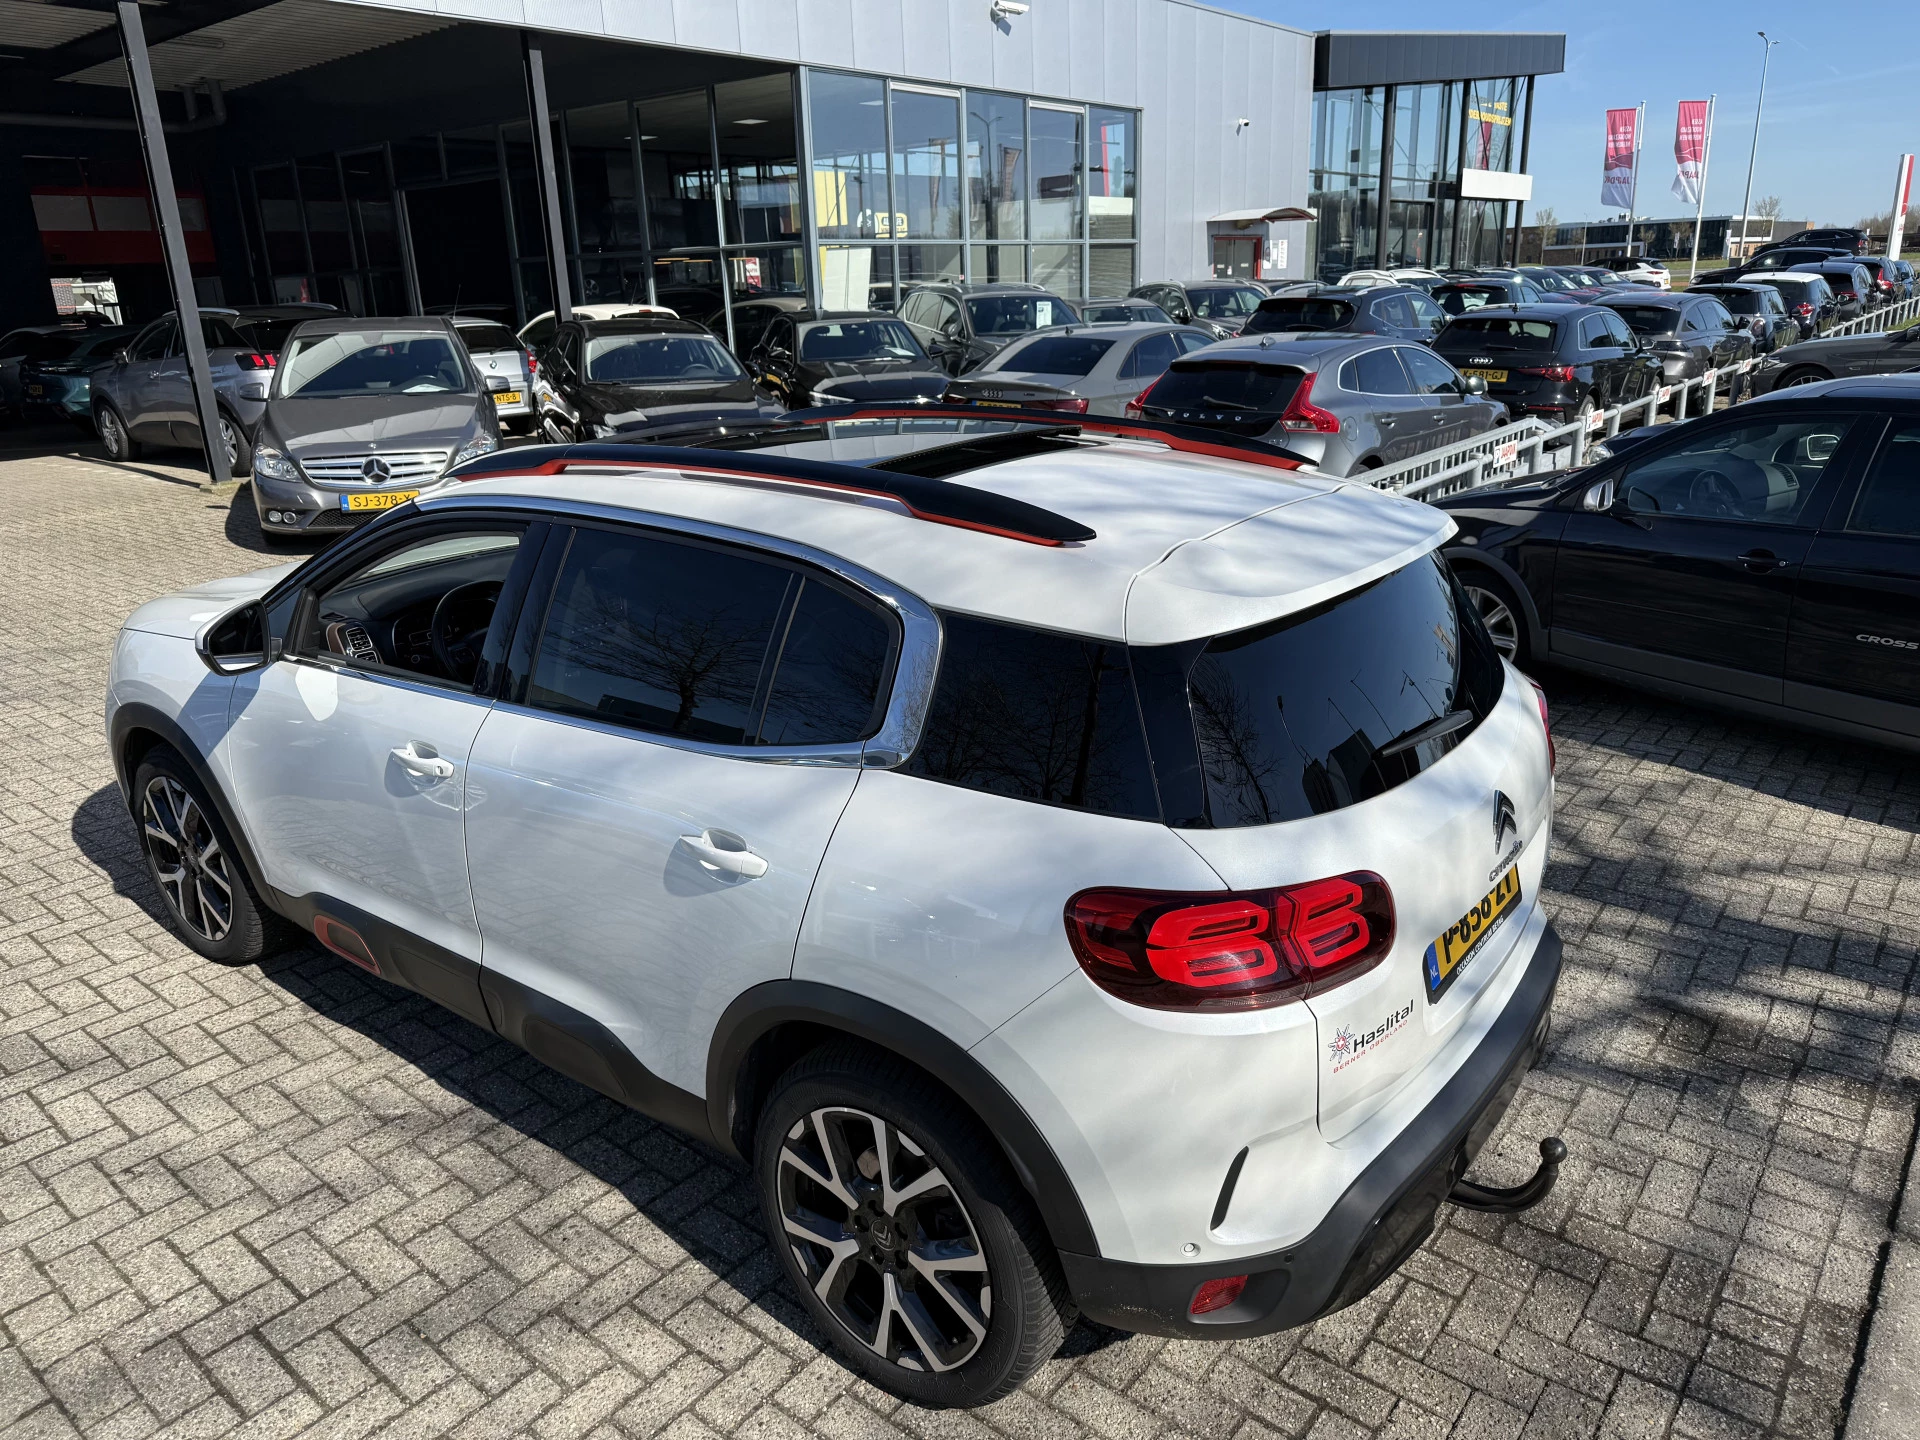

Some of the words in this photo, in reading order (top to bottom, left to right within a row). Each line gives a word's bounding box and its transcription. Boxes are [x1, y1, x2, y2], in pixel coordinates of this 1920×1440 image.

[1167, 410, 1242, 422] VOLVO
[1856, 634, 1919, 650] CROSS
[1430, 965, 1439, 980] NL
[1353, 999, 1414, 1053] Haslital
[1333, 1049, 1367, 1074] BERNER
[1369, 1019, 1408, 1050] OBERLAND
